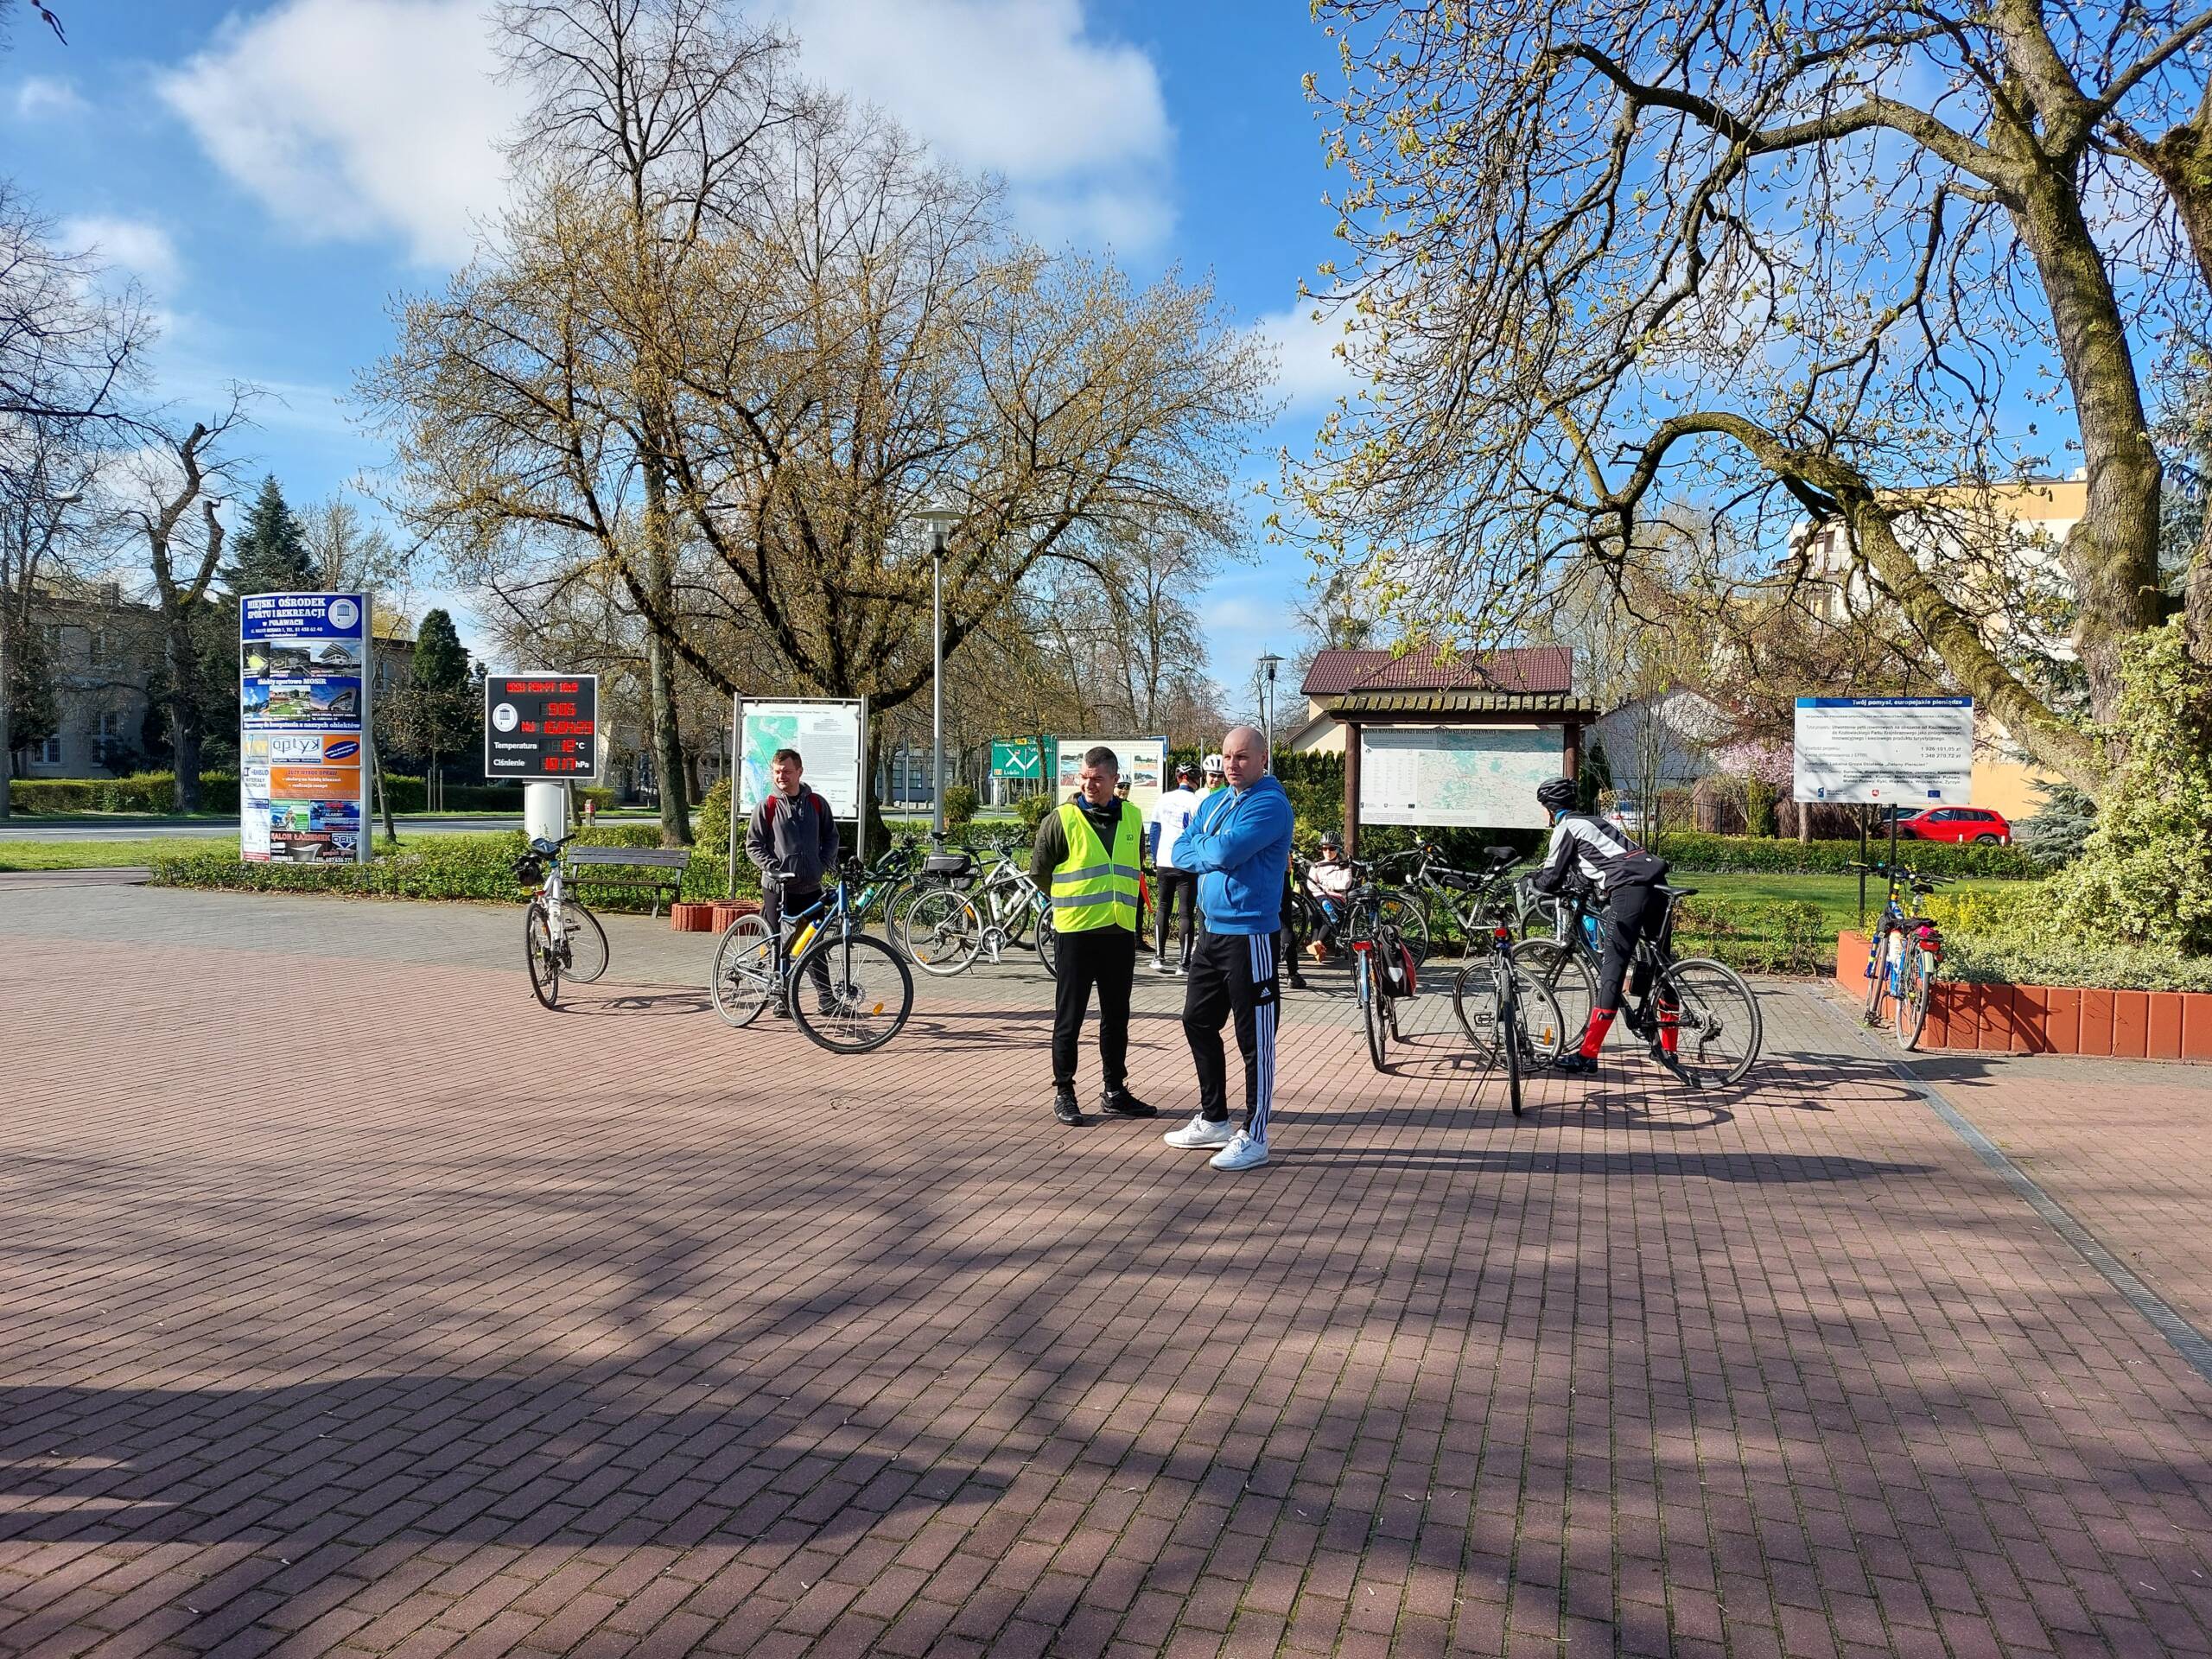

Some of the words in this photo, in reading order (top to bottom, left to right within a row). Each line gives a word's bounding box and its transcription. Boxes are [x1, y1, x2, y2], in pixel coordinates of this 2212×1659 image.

[247, 599, 276, 609] MIEJSKI
[278, 596, 326, 607] OŚRODEK
[247, 610, 271, 619] SPORTU
[276, 608, 326, 618] REKREACJI
[270, 833, 292, 842] SALON
